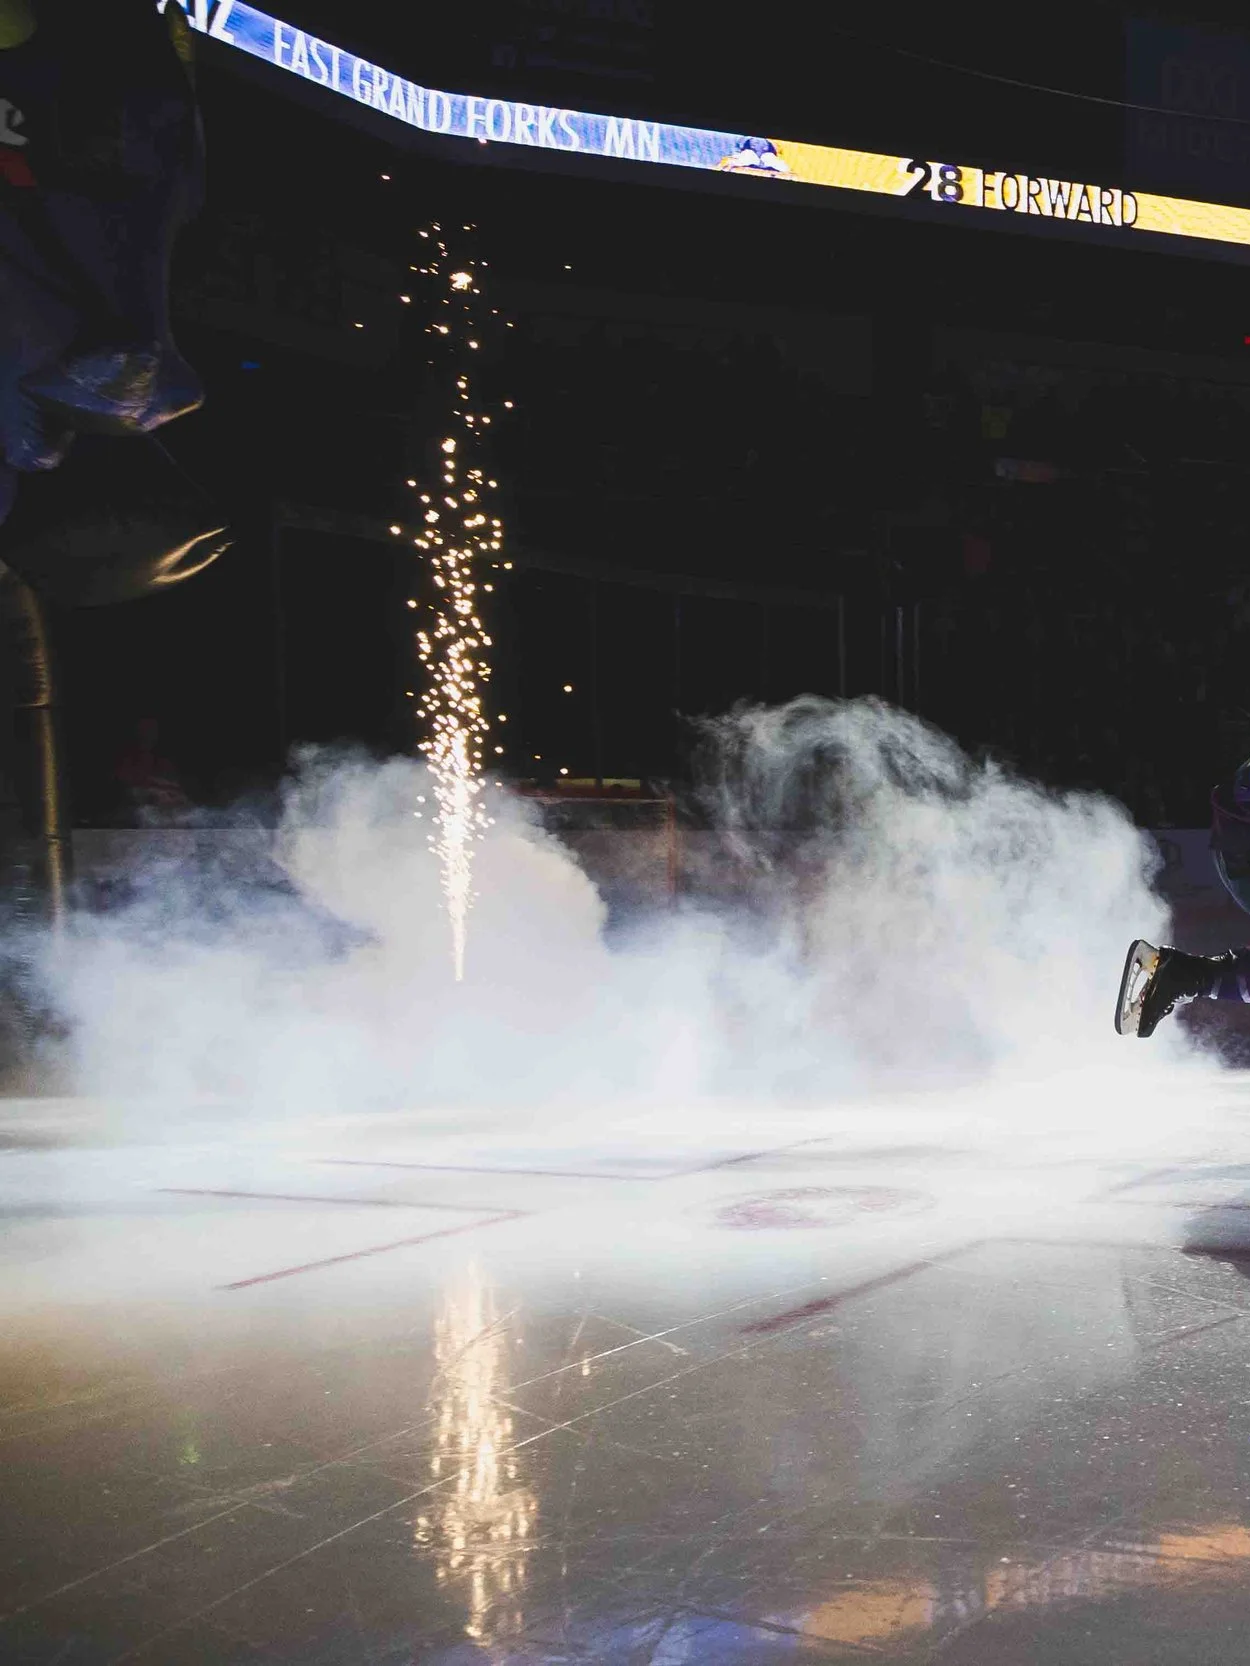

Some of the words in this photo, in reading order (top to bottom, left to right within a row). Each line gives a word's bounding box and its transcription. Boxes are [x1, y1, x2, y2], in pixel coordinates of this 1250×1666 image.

[274, 19, 343, 92] EAST
[352, 57, 452, 132] GRAND
[466, 96, 580, 152] FORKS
[604, 115, 660, 163] MN
[906, 158, 964, 203] 28
[982, 168, 1139, 227] FORWARD
